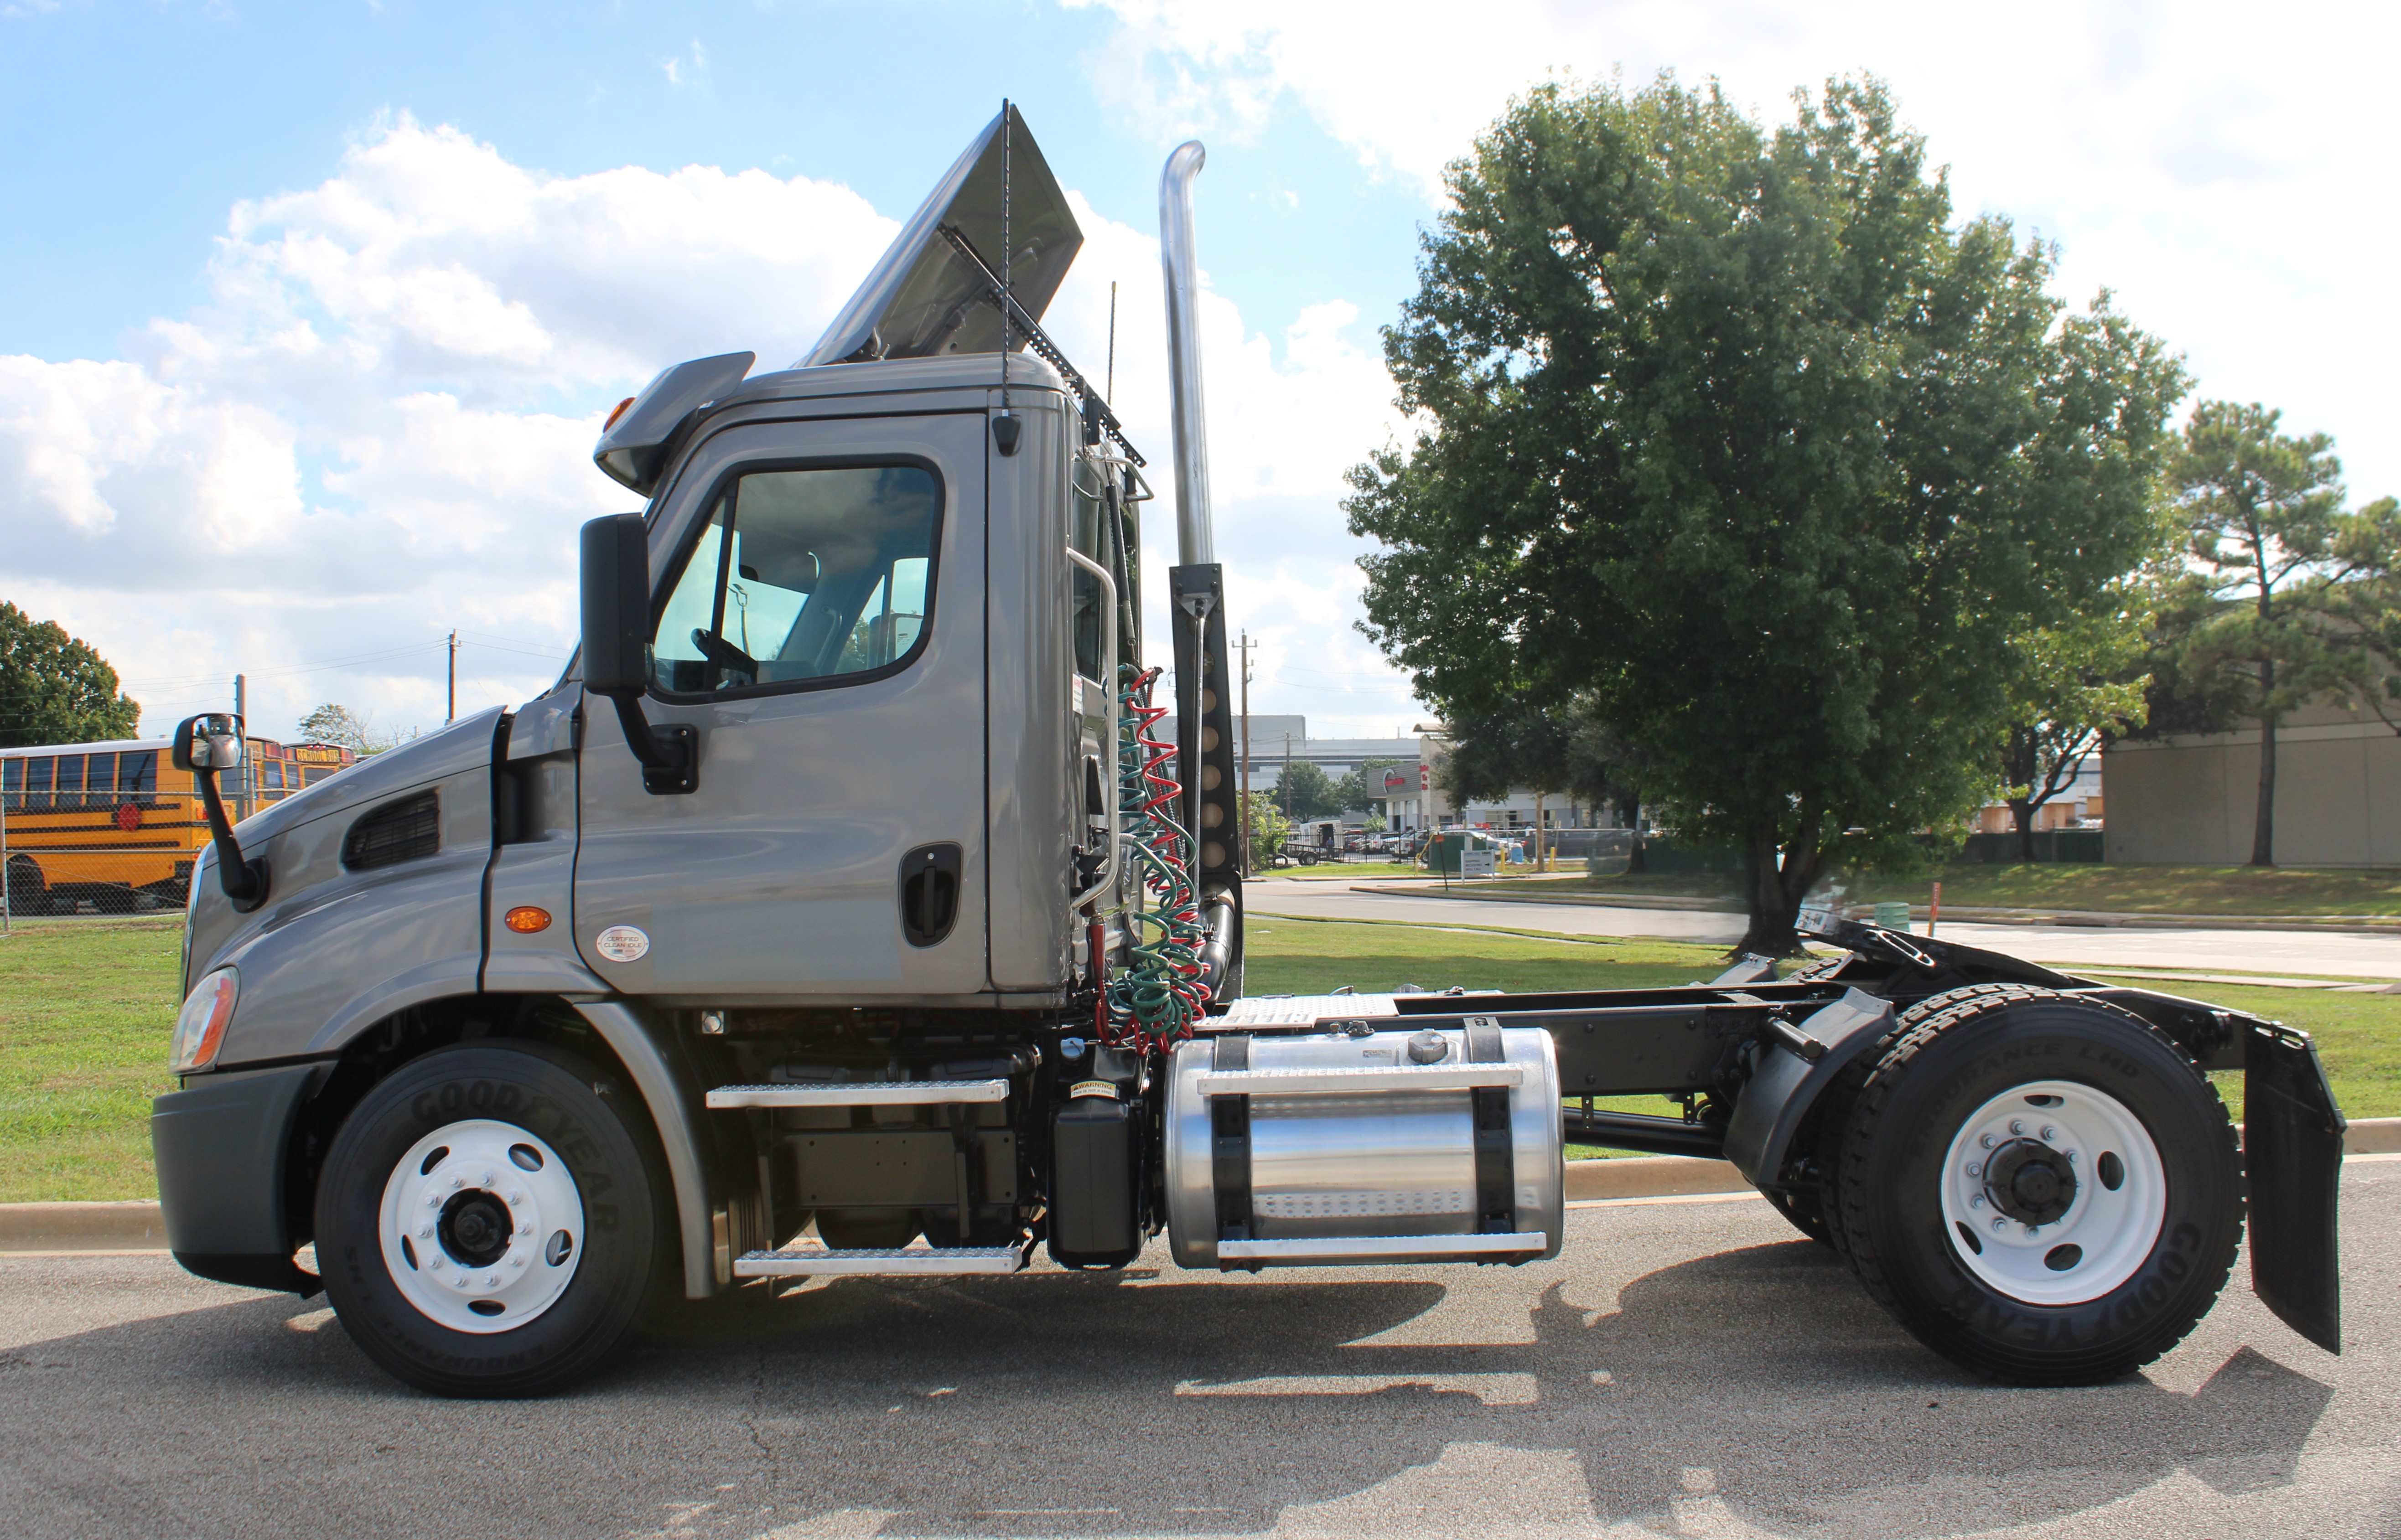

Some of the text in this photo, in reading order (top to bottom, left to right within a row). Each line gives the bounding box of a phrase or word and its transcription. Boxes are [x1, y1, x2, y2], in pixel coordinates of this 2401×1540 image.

[298, 750, 339, 761] SCHOOL BUS
[412, 1080, 621, 1233] GOODYEAR
[1909, 1043, 2062, 1158] ENDURANCE
[1949, 1221, 2201, 1349] GOODYEAR
